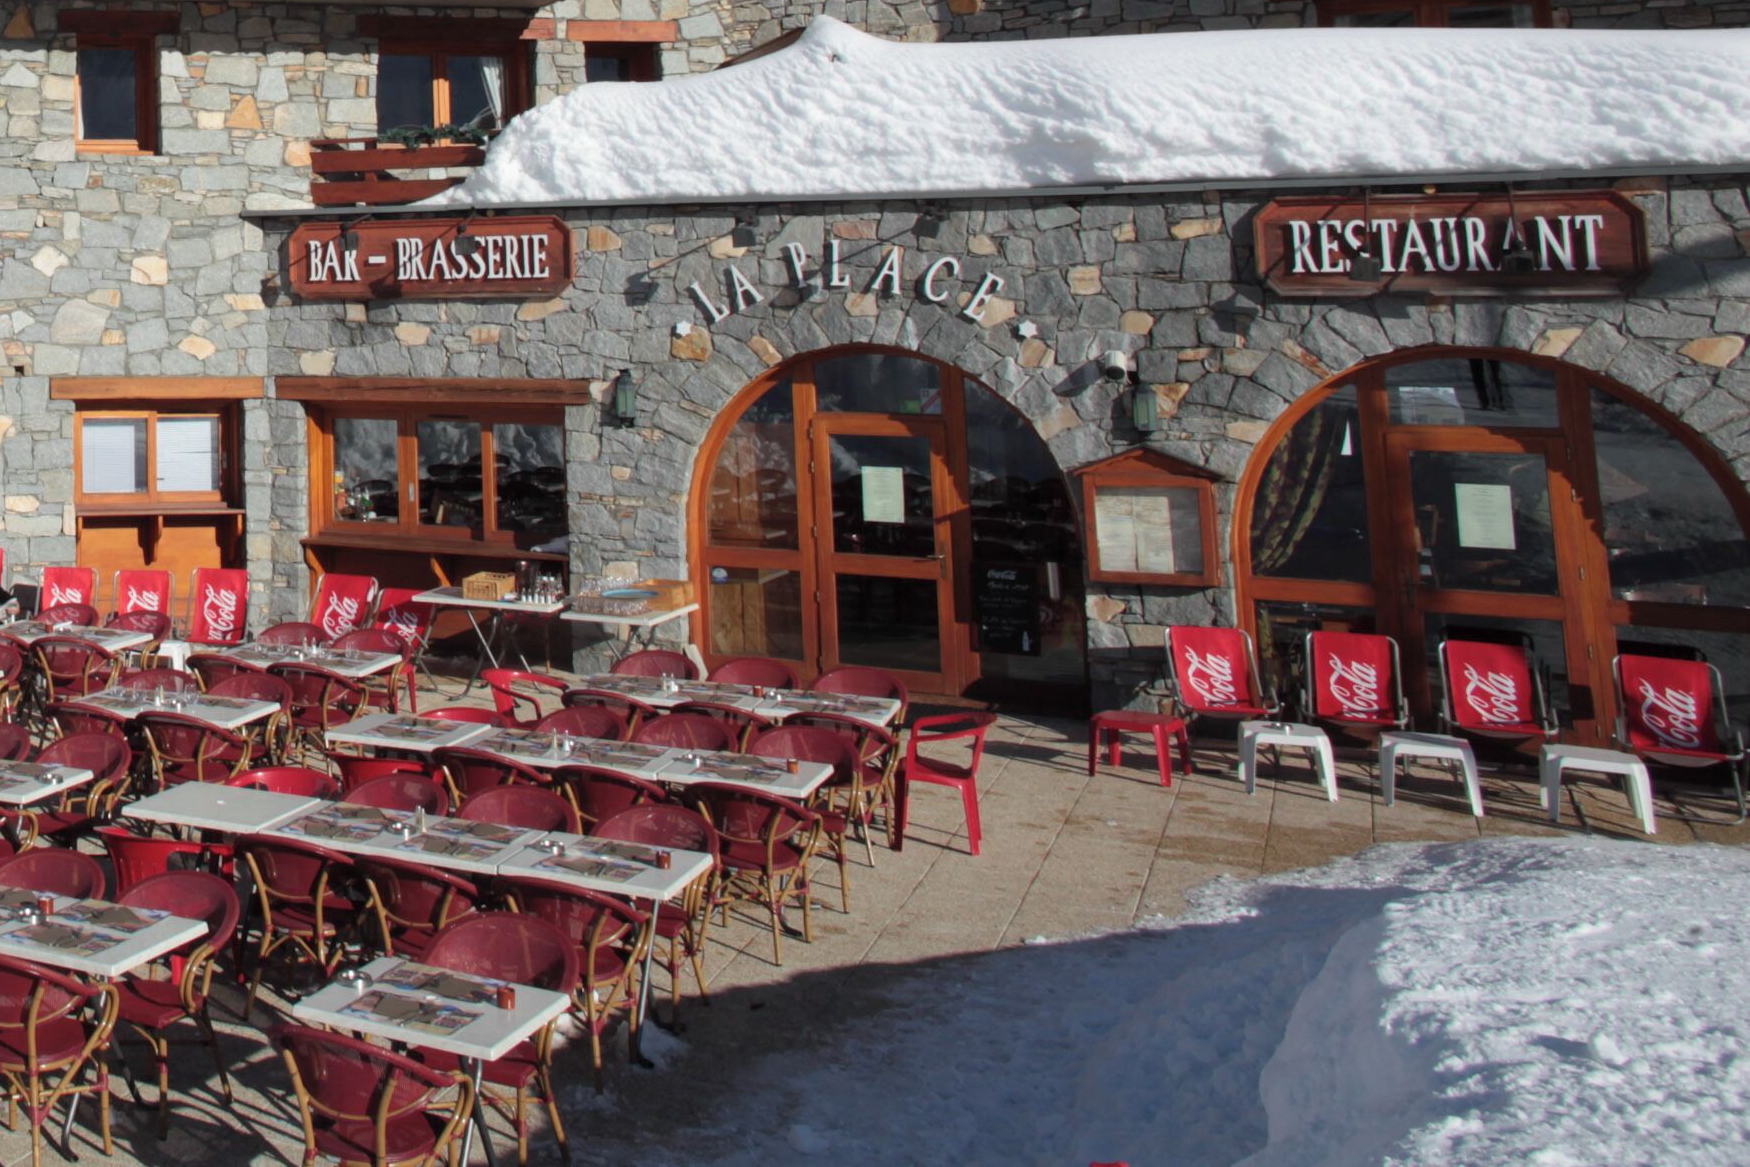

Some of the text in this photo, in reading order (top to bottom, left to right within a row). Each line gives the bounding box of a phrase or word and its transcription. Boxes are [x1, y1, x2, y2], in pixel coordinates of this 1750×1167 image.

[308, 238, 362, 282] BAR
[395, 234, 550, 281] BRASSERIE
[687, 238, 1005, 324] LA PLACE
[1638, 677, 1700, 748] Cola
